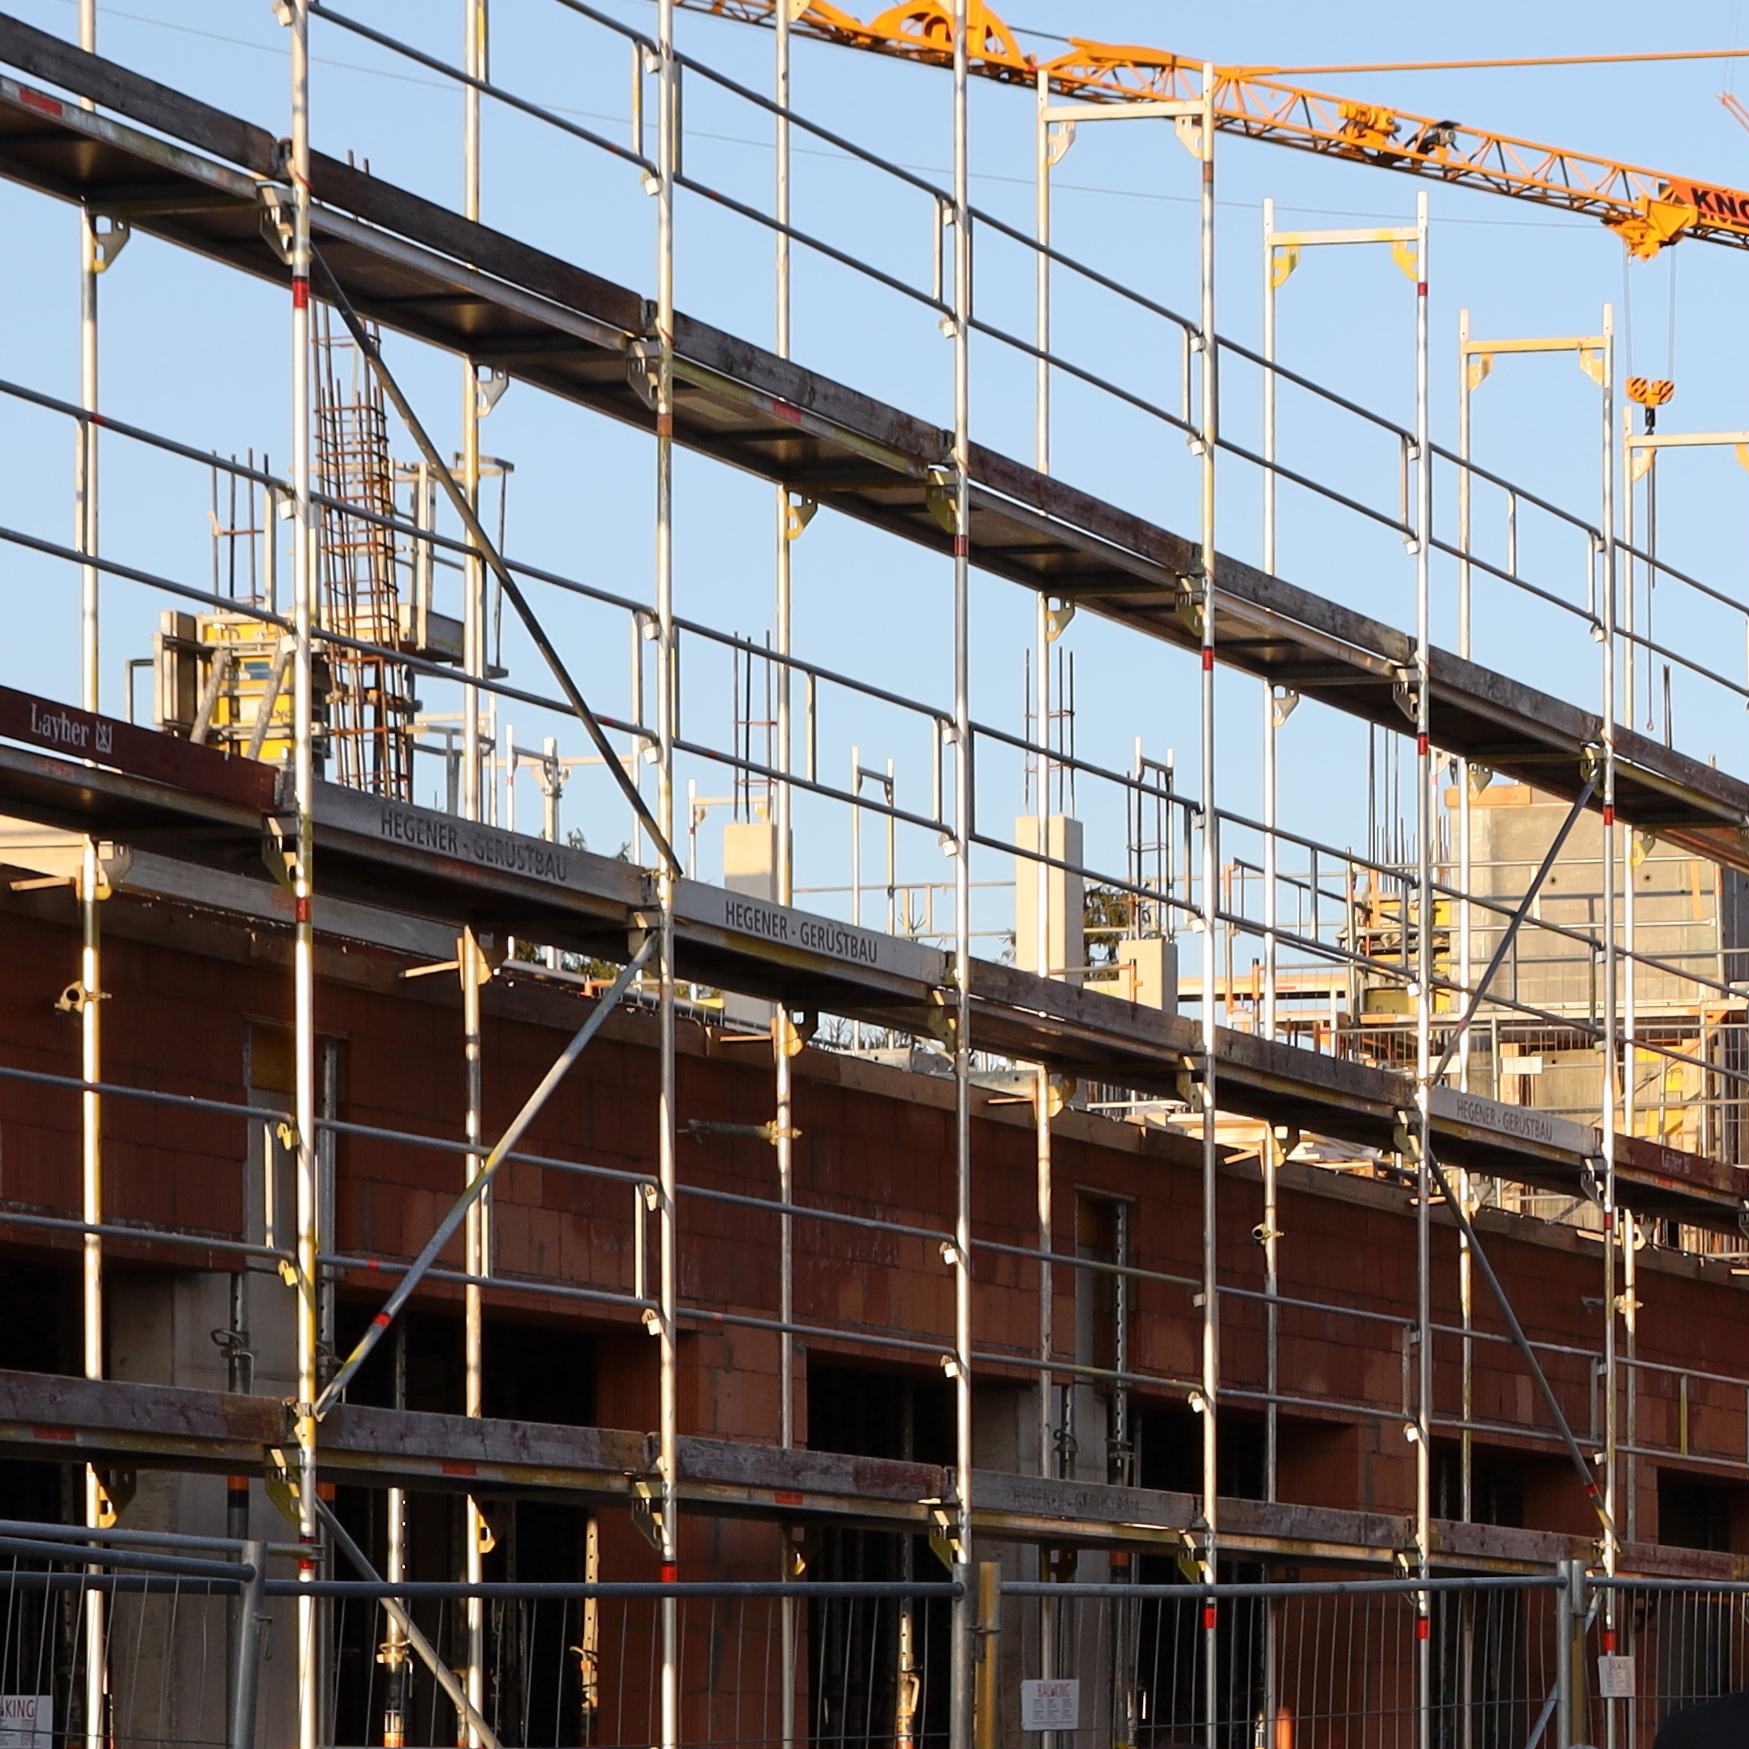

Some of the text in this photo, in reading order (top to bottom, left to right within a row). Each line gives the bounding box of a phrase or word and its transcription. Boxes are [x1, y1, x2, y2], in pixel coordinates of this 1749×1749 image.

[30, 703, 90, 747] Layher
[381, 808, 459, 854] HEGENER
[473, 833, 569, 881] GERÜSTBAU
[725, 900, 788, 940] HEGENER
[800, 921, 878, 963] GERÜSTBAU
[1456, 1099, 1496, 1127] HEGENER
[1503, 1111, 1553, 1141] GERÜSTBAU
